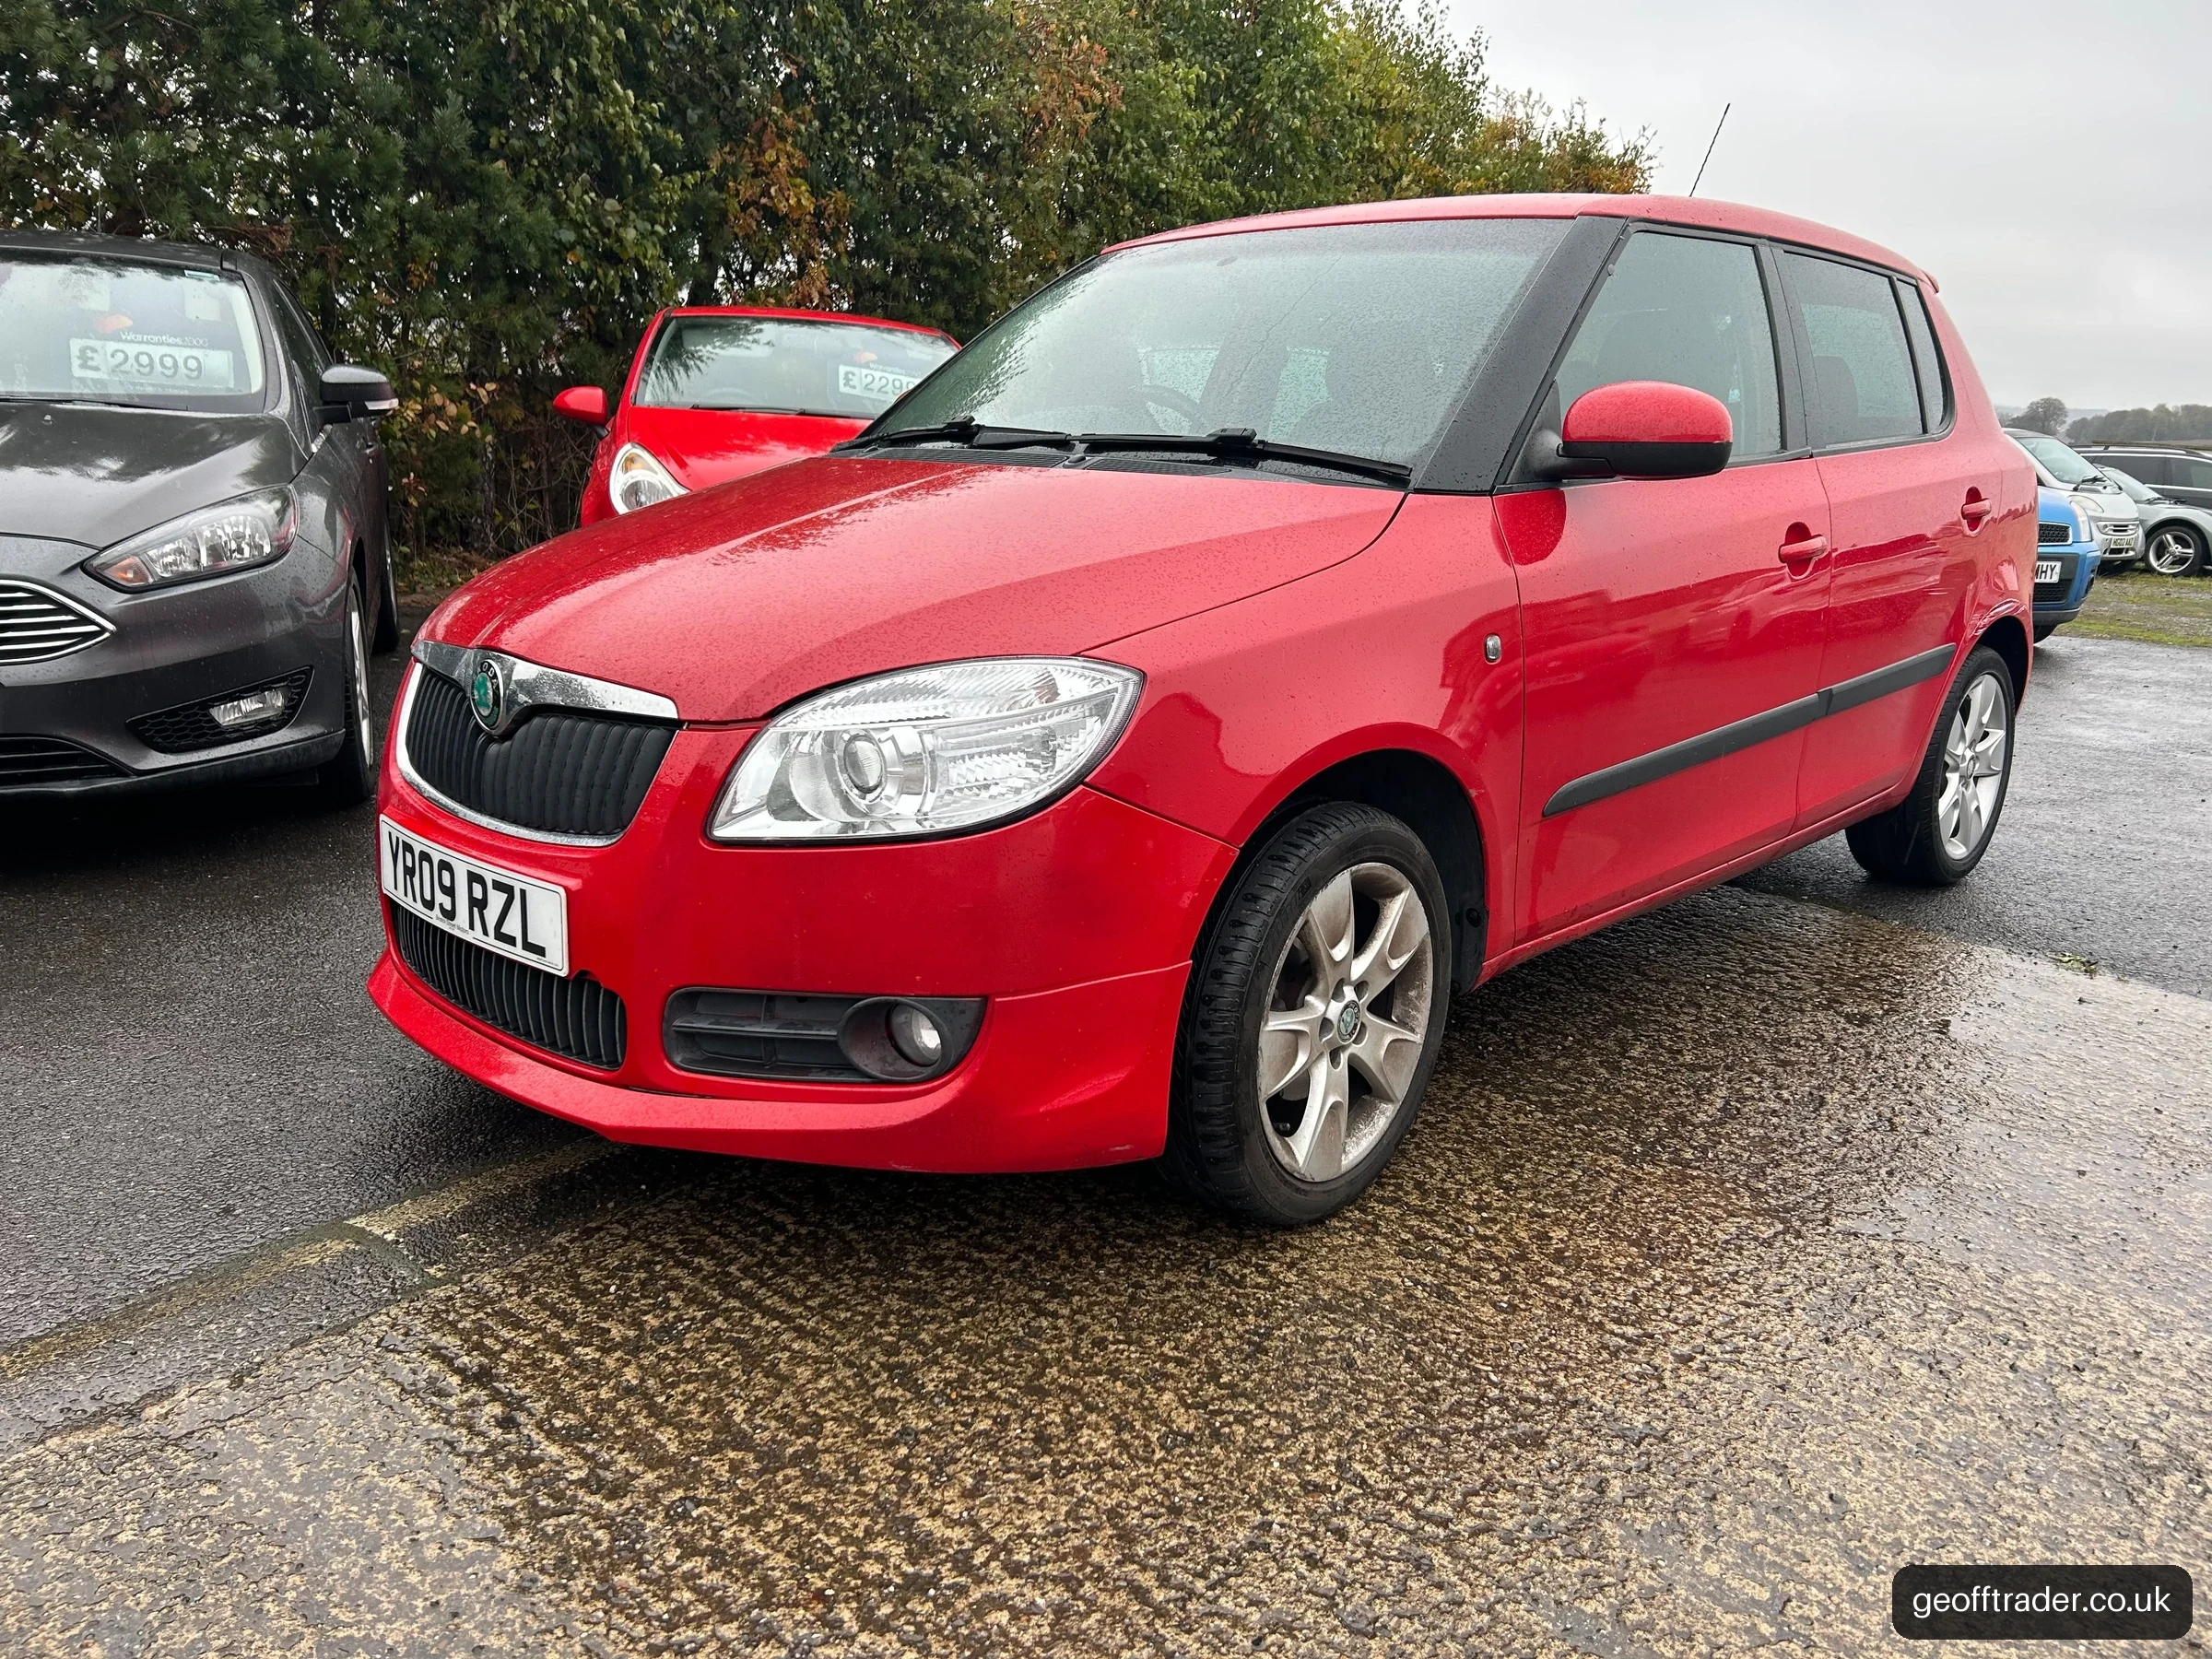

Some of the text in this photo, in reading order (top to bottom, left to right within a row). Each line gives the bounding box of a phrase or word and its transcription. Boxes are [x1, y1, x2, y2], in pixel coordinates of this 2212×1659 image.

[76, 345, 203, 380] £2999
[388, 831, 547, 958] YR09 RZL
